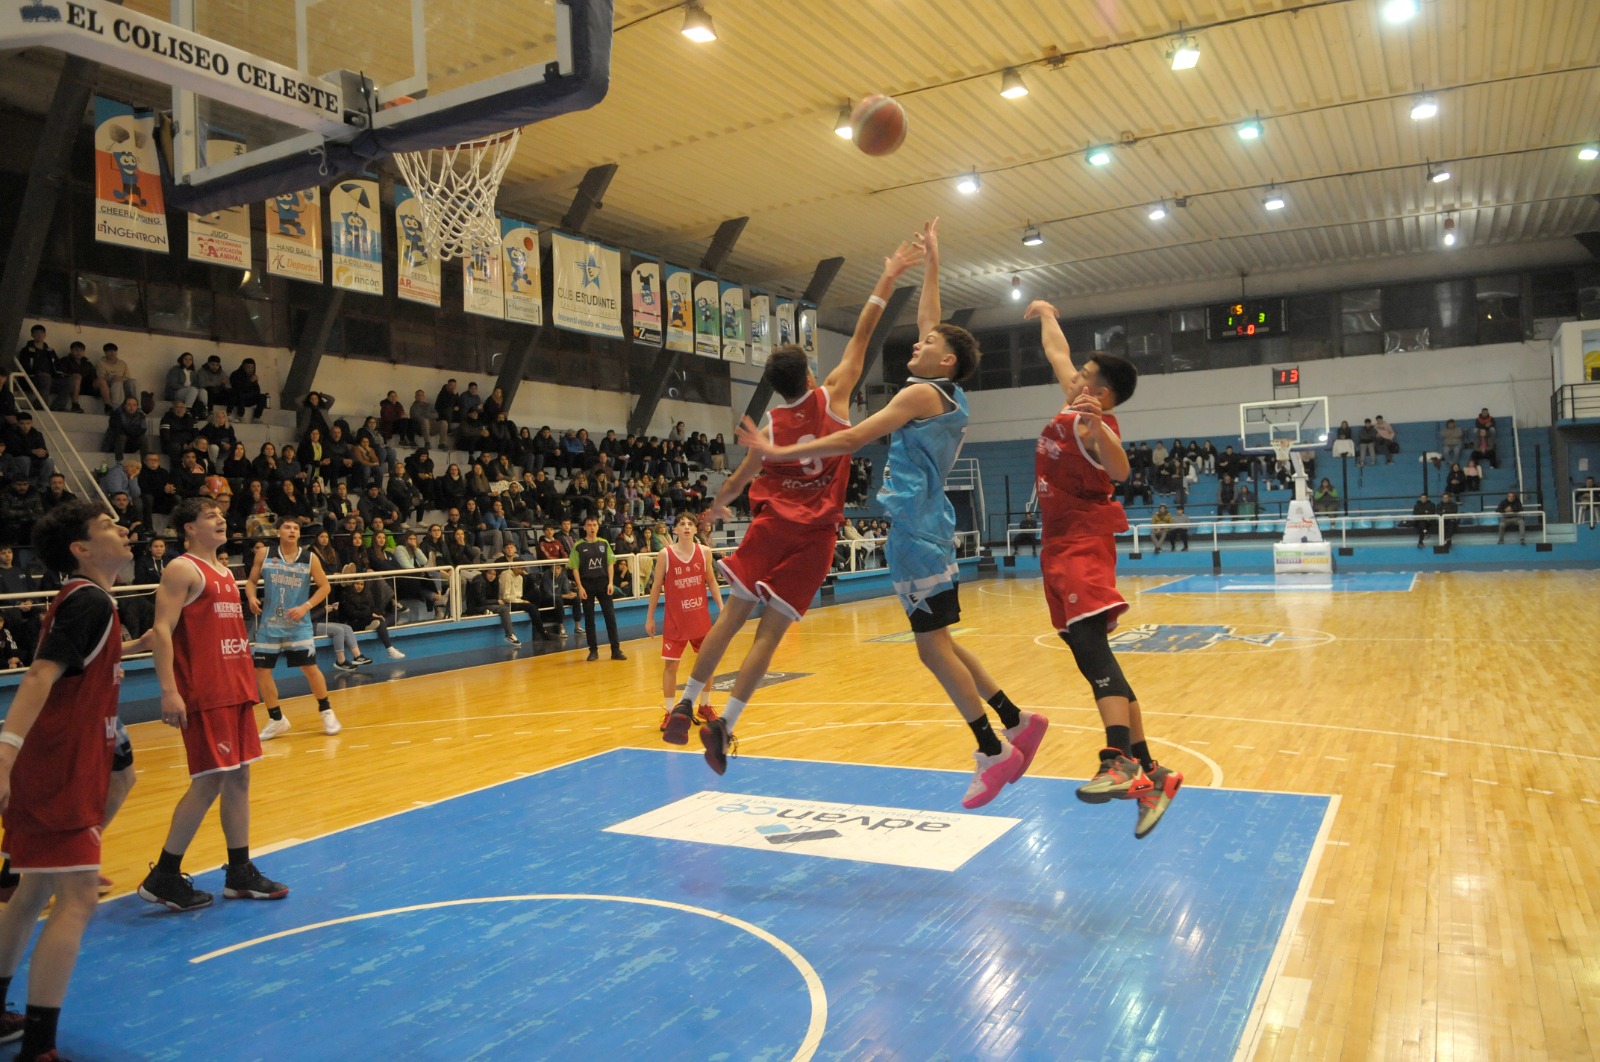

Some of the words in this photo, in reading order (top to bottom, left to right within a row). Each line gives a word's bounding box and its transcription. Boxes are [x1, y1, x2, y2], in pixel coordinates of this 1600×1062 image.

[66, 1, 104, 35] EL
[113, 19, 229, 75] COLISEO
[237, 61, 339, 114] CELESTE
[211, 231, 228, 239] JUDO
[220, 253, 243, 262] ANIMAL
[287, 259, 318, 273] Deportes
[1258, 312, 1265, 323] 3
[1280, 369, 1299, 383] 13
[214, 581, 221, 594] 7
[715, 801, 953, 834] advance
